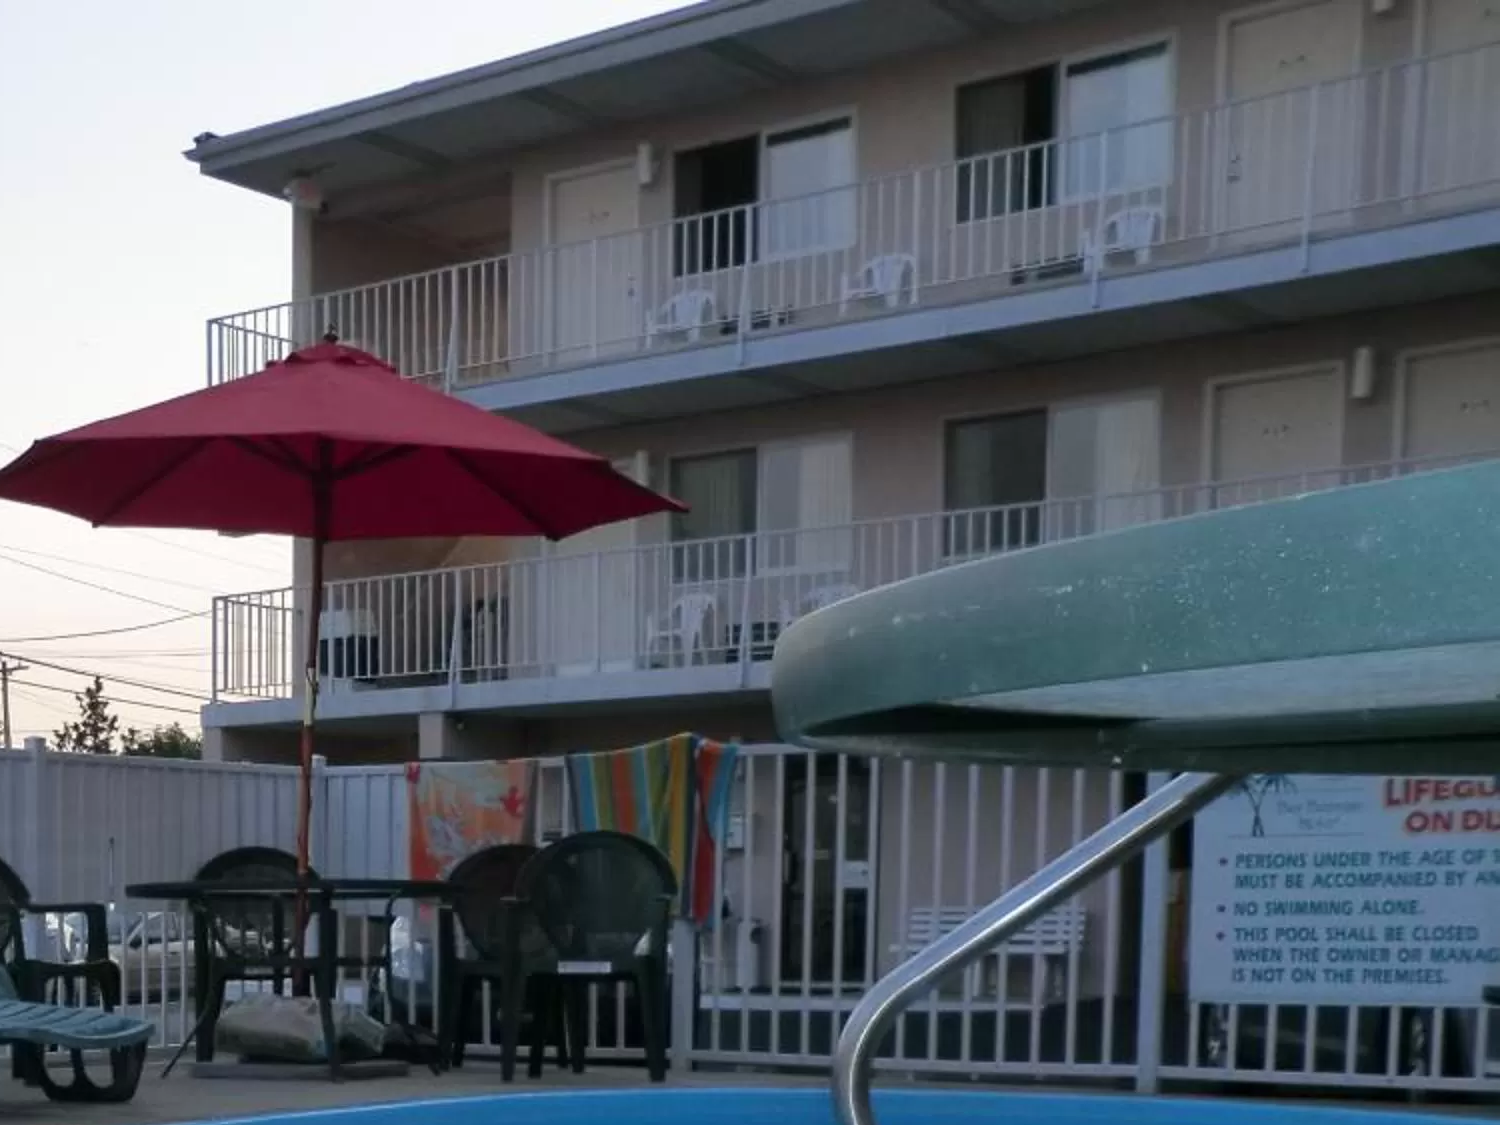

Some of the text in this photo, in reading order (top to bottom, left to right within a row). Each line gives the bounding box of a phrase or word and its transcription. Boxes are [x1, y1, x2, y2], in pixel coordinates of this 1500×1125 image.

[1405, 810, 1454, 833] ON
[1235, 853, 1307, 868] PERSONS
[1313, 851, 1371, 867] UNDER
[1377, 850, 1412, 866] THE
[1418, 849, 1456, 865] AGE
[1461, 848, 1486, 865] OF
[1235, 873, 1277, 889] MUST
[1284, 873, 1304, 888] BE
[1311, 871, 1437, 888] ACCOMPANIED
[1444, 870, 1467, 887] BY
[1233, 899, 1425, 916] NO SWIMMING ALONE.
[1234, 924, 1479, 941] THIS POOL SHALL BE CLOSED
[1232, 947, 1283, 962] WHEN
[1289, 946, 1320, 962] THE
[1327, 946, 1391, 962] OWNER
[1397, 947, 1422, 962] OR
[1231, 967, 1449, 984] IS NOT ON THE PREMISES.
